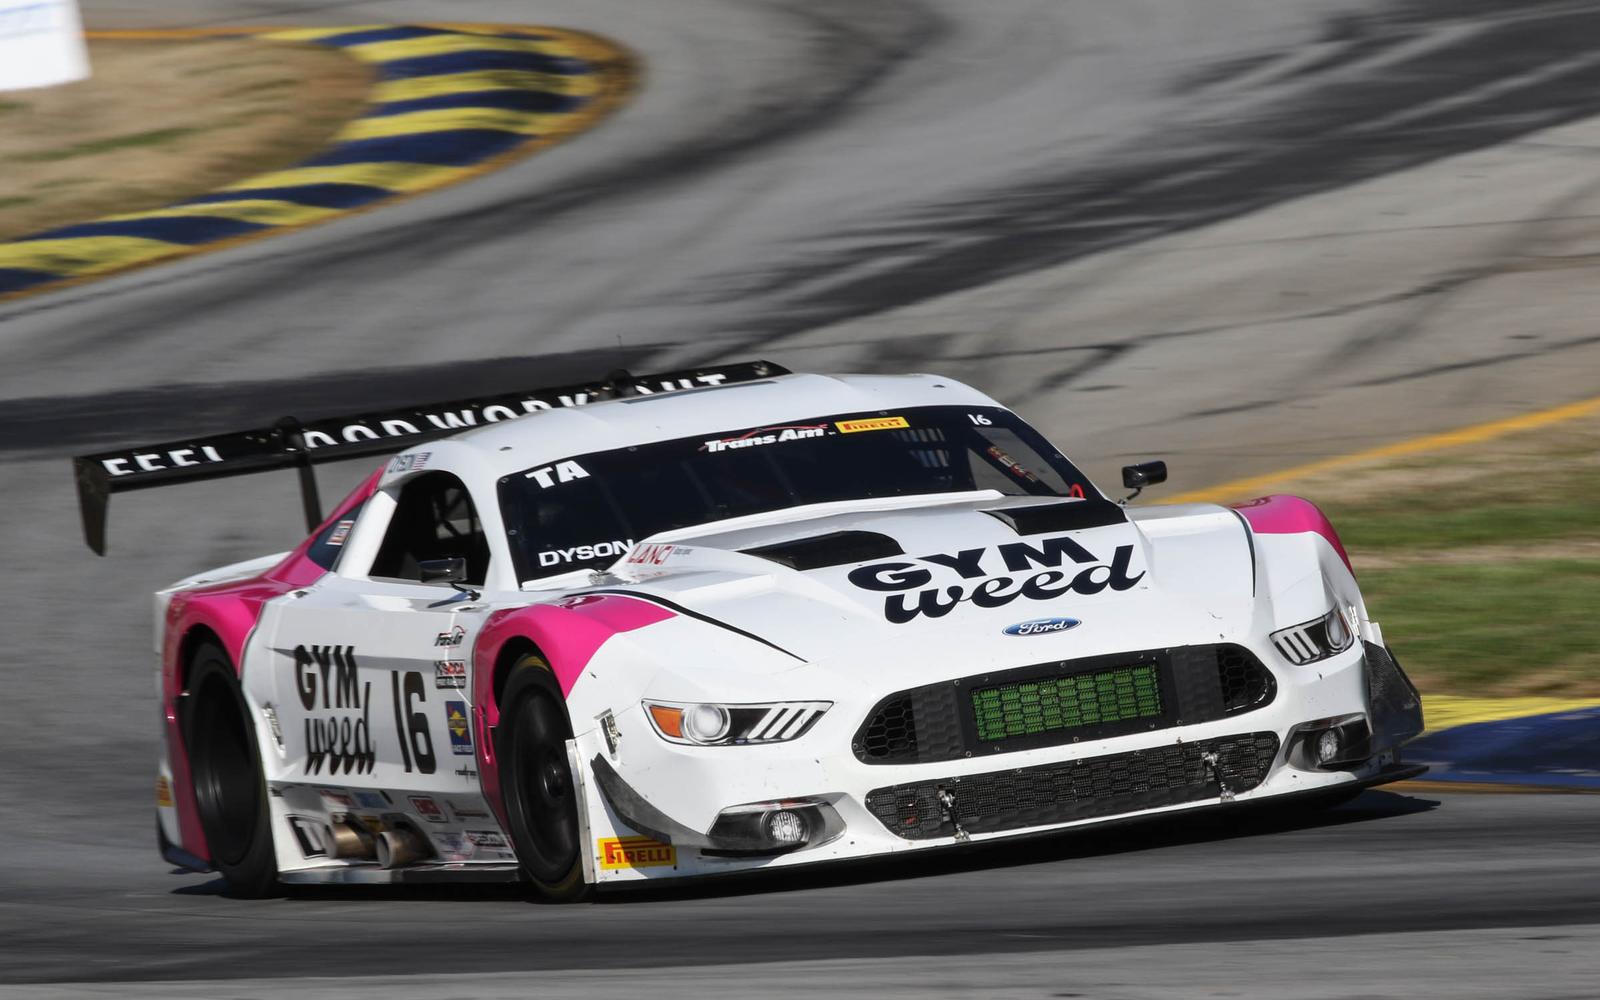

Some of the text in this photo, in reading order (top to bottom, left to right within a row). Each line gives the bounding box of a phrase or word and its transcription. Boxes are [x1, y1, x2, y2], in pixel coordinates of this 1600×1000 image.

[843, 417, 903, 431] PIRELLI
[967, 413, 993, 427] 16
[704, 428, 825, 453] Trans Am
[524, 460, 591, 489] TA
[537, 539, 634, 567] DYSON
[847, 536, 1099, 592] GYM
[884, 544, 1146, 624] weed
[1018, 619, 1069, 636] Ford
[294, 644, 360, 711] GYM
[304, 681, 376, 776] weed
[391, 670, 436, 774] 16
[604, 840, 672, 865] PIRELLI
